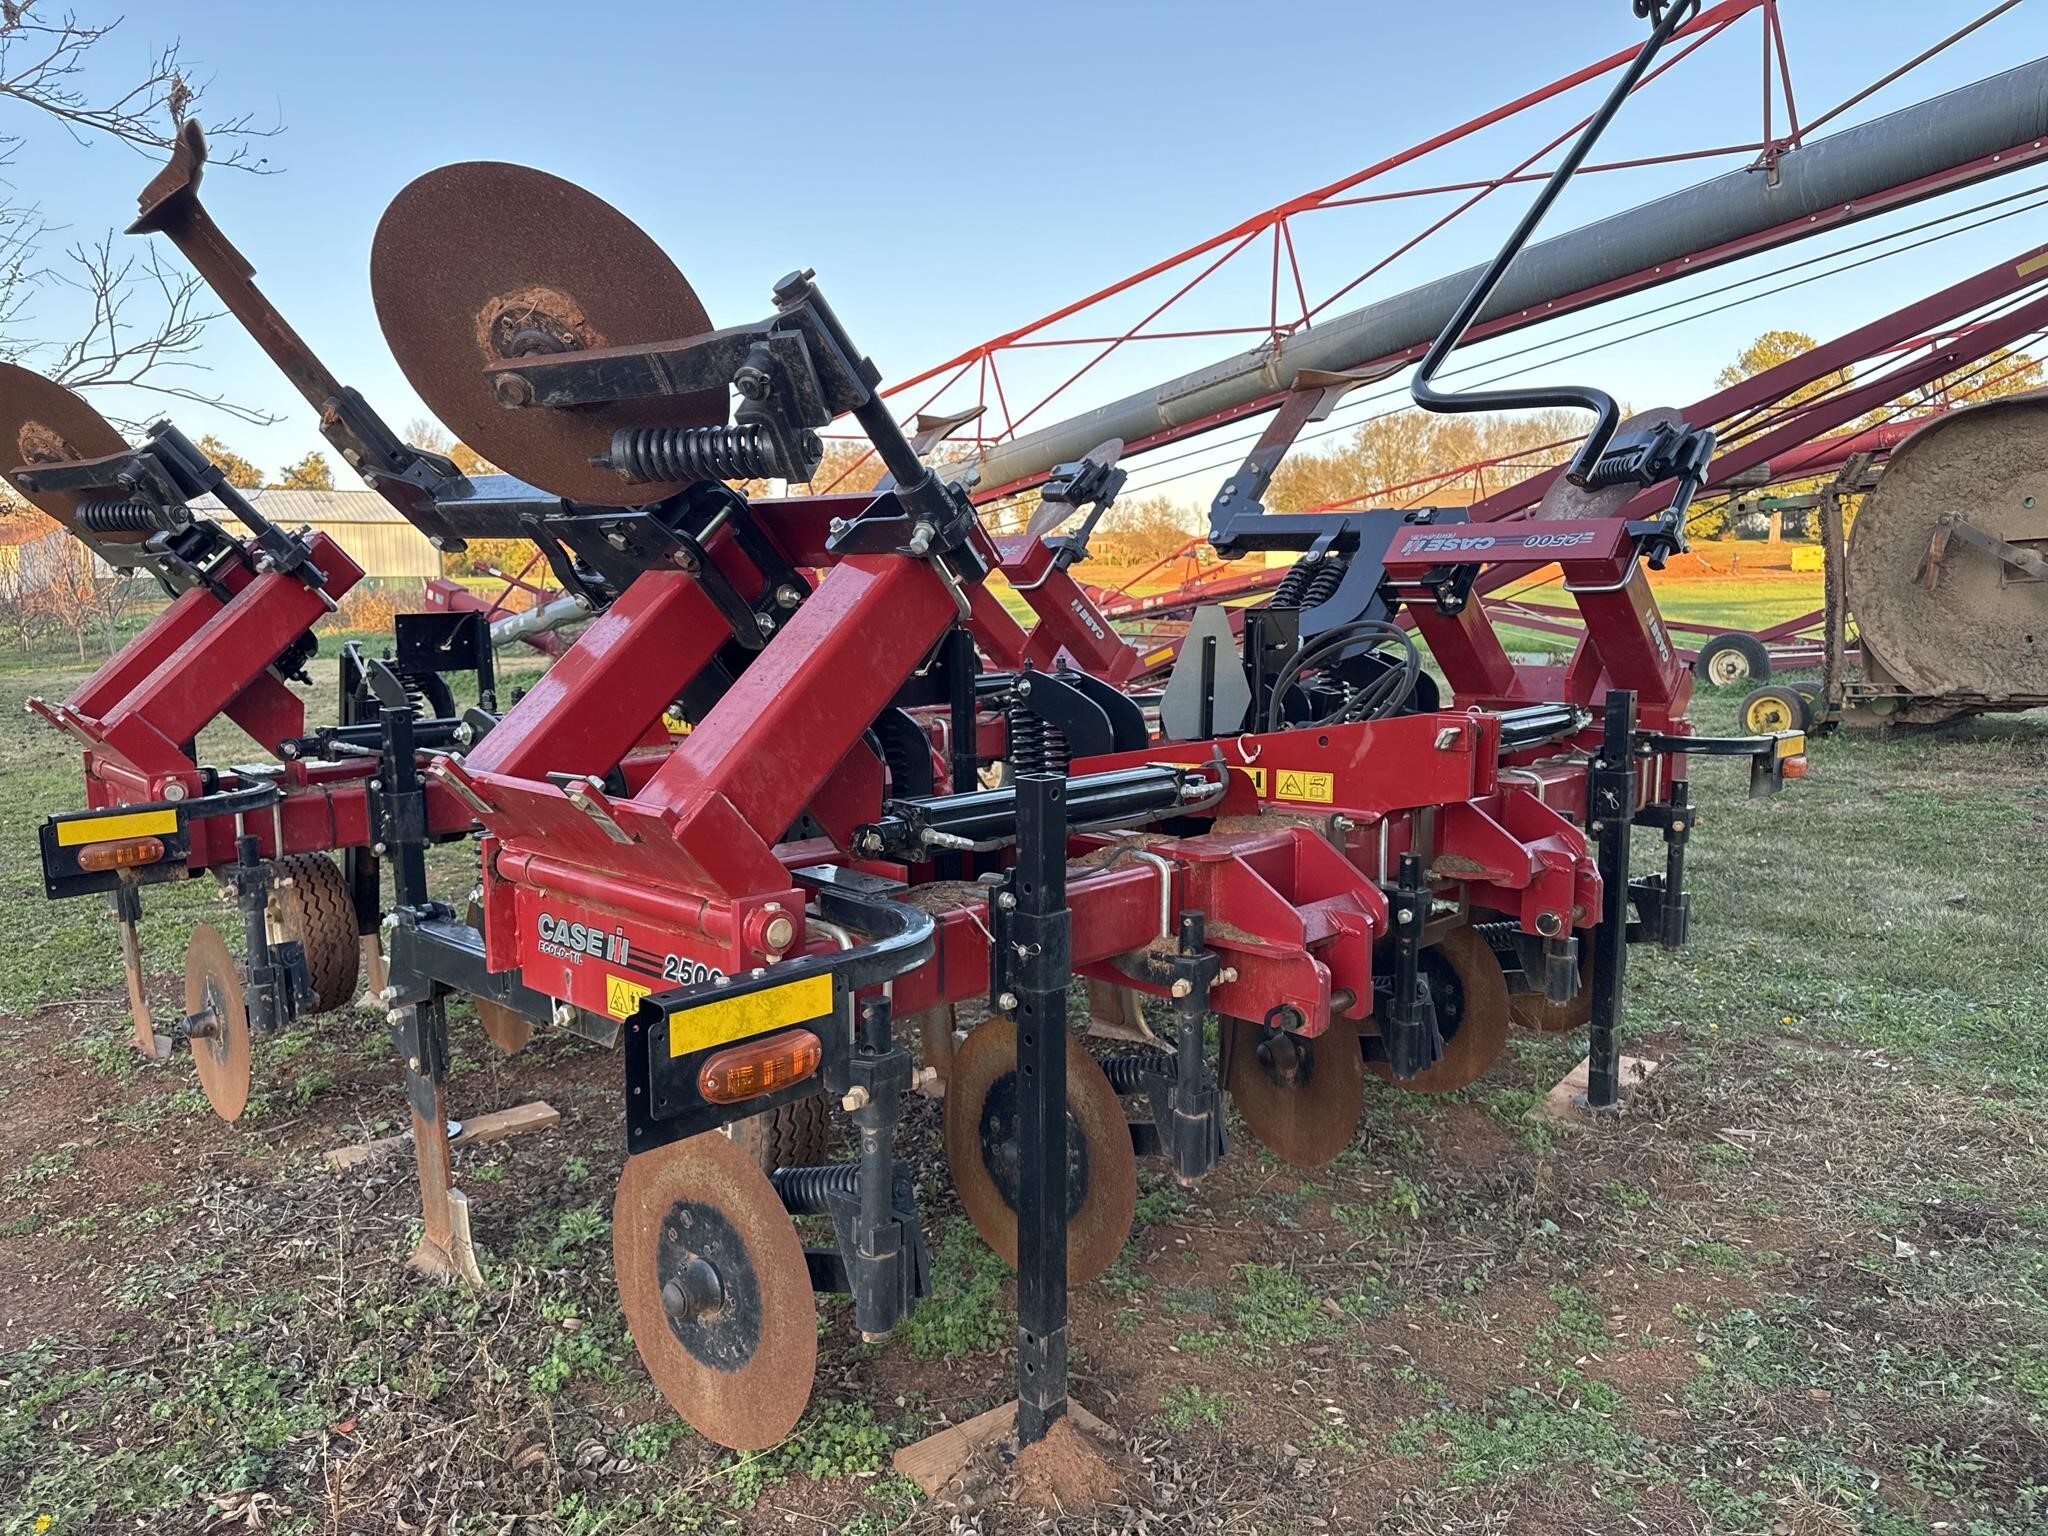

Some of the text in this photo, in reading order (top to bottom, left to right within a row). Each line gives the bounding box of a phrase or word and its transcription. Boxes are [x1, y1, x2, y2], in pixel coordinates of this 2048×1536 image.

[1424, 536, 1496, 551] CASE
[1524, 532, 1583, 548] 2500
[1079, 608, 1105, 640] CASE
[537, 913, 604, 958] CASE
